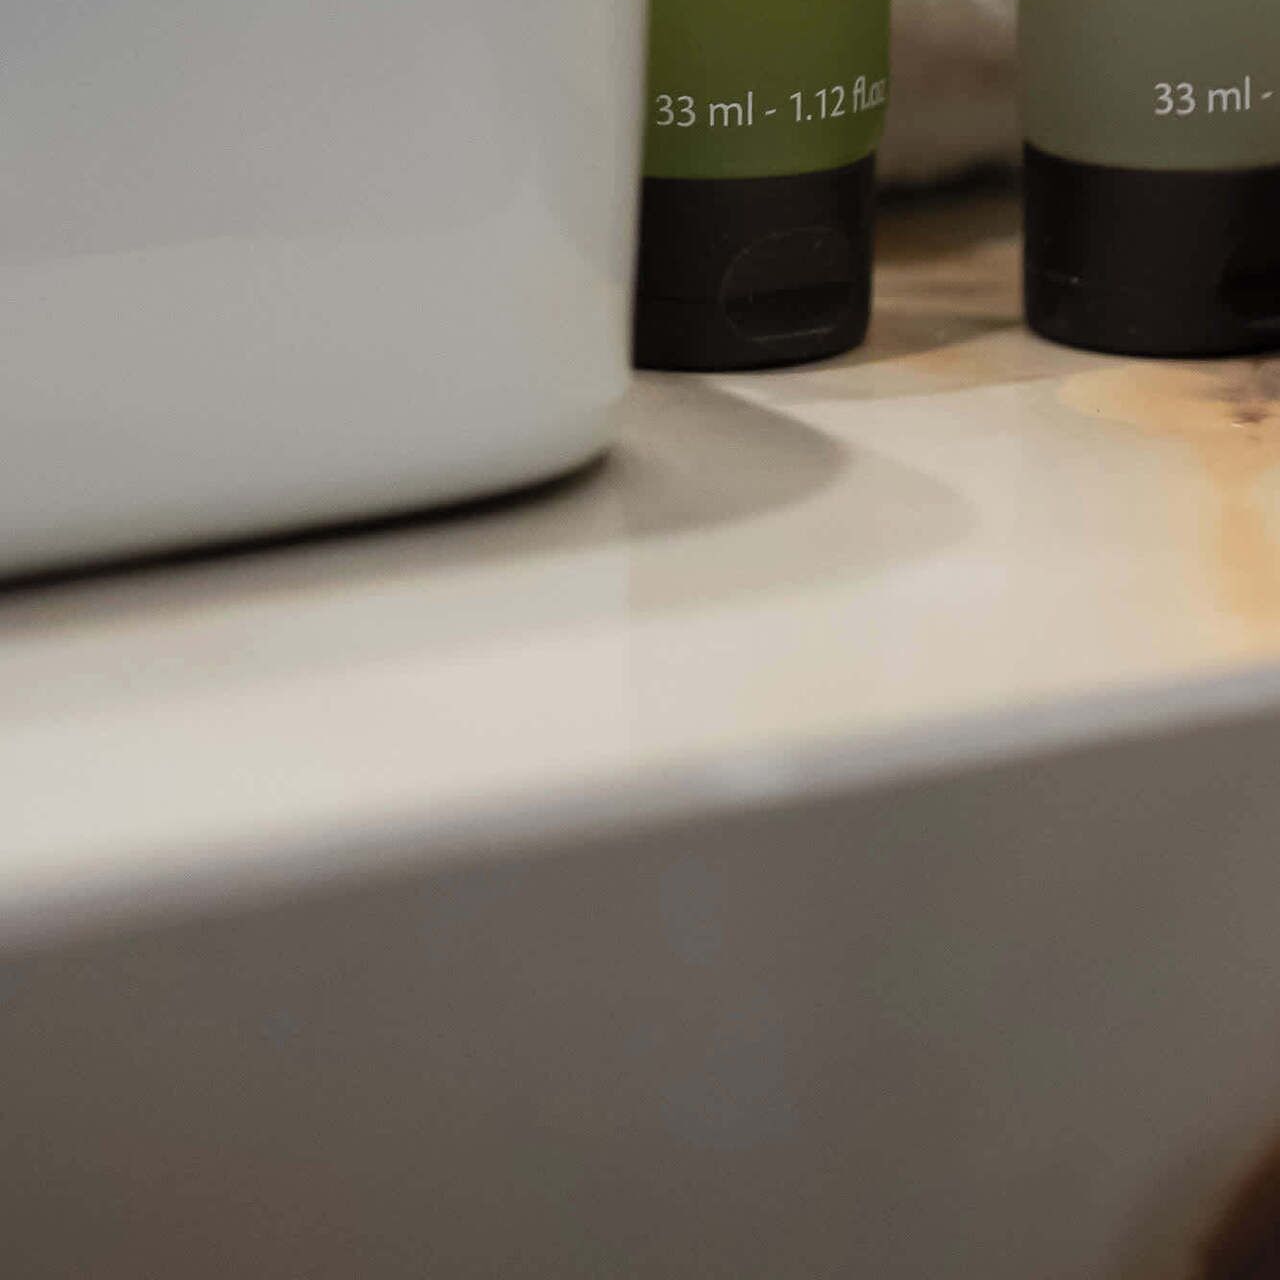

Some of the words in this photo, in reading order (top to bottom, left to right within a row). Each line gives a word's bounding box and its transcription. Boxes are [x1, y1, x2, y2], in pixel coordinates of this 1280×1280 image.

[655, 94, 696, 127] 33
[709, 91, 753, 127] ml
[789, 85, 846, 123] 1.12
[1154, 82, 1196, 116] 33
[1207, 75, 1251, 113] ml
